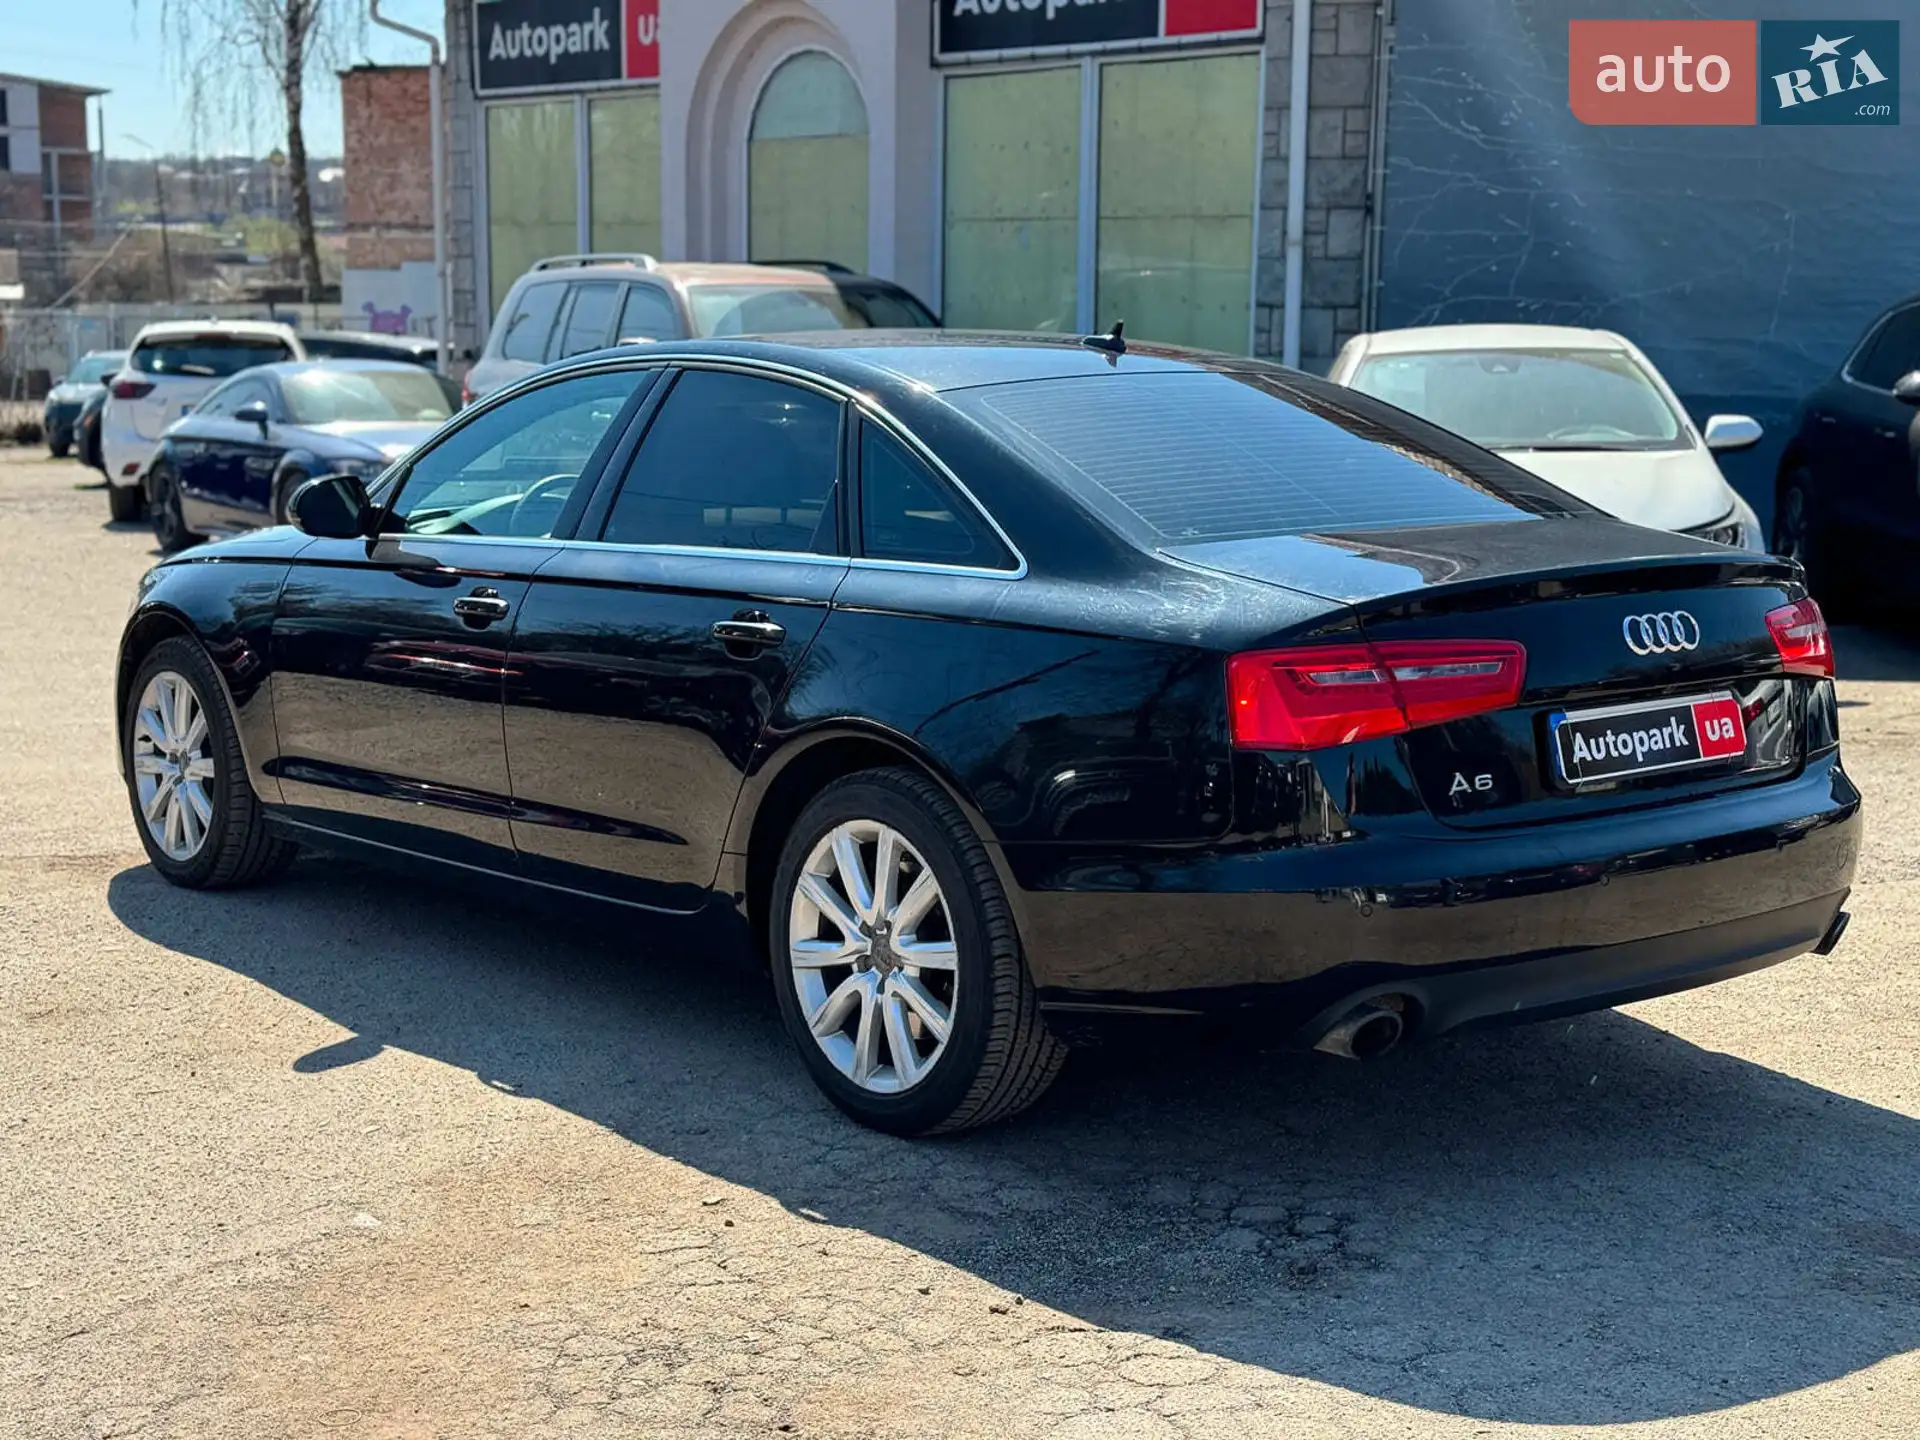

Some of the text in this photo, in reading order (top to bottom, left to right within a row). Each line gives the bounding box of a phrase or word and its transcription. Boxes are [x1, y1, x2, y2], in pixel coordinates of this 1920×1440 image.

[488, 6, 660, 65] Autopark u
[1572, 715, 1735, 764] Autopark ua
[1448, 771, 1493, 796] A6
